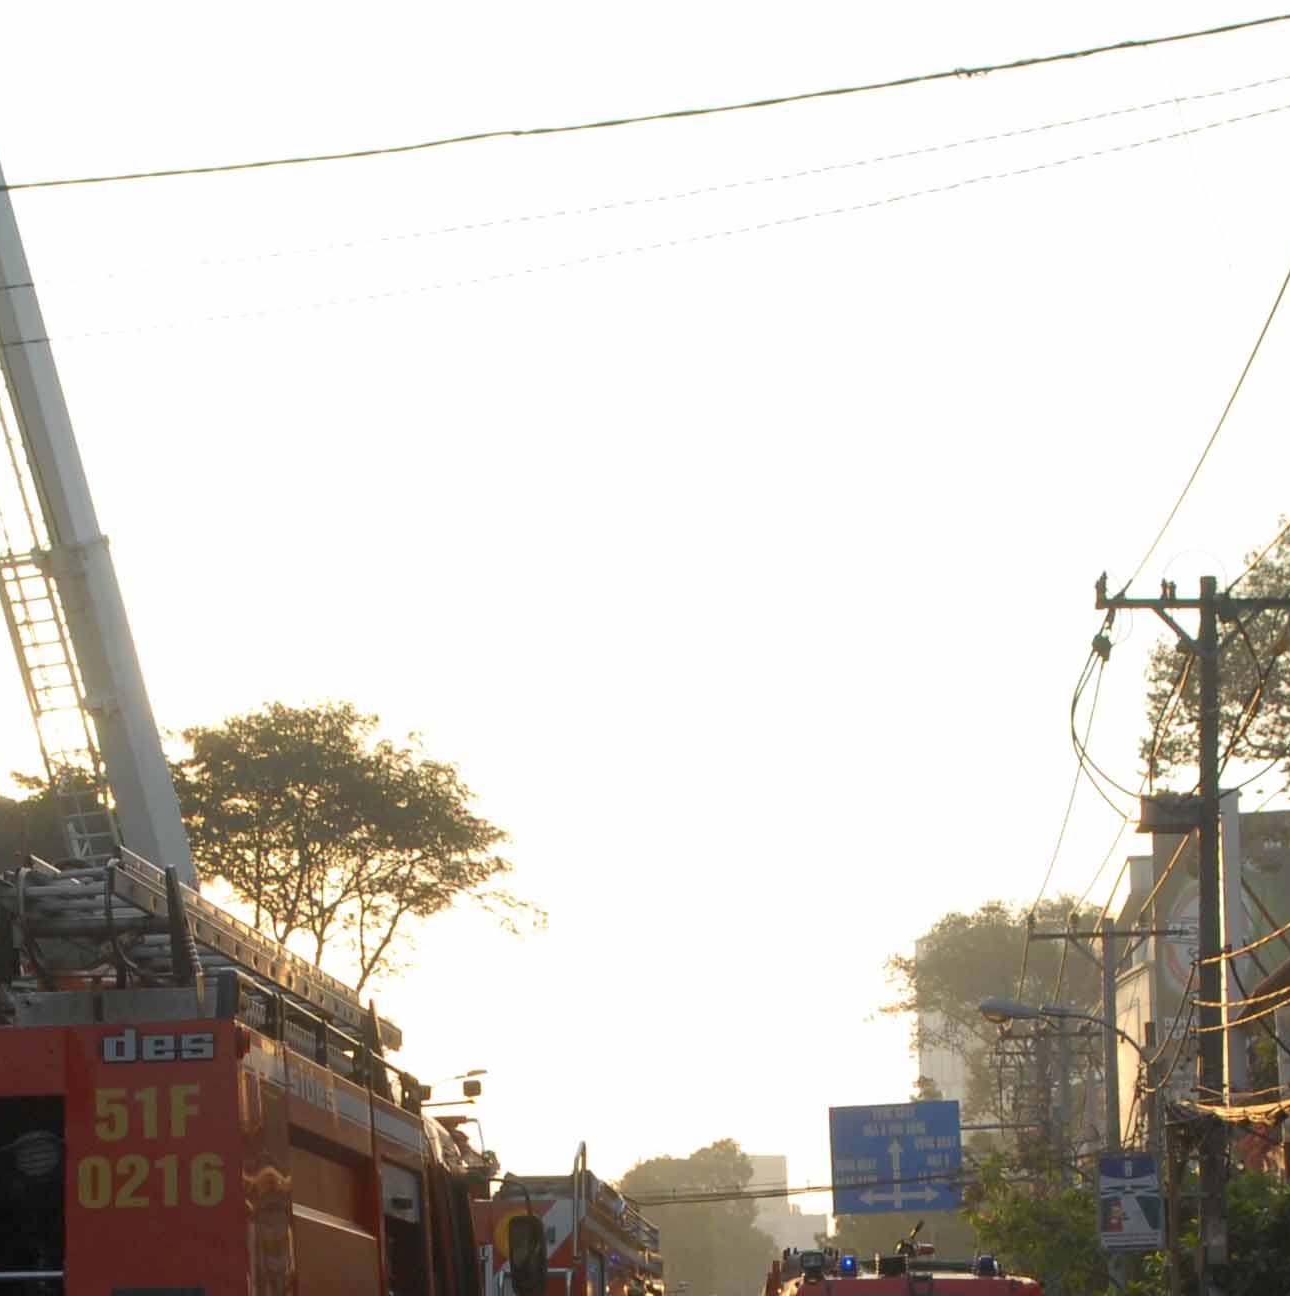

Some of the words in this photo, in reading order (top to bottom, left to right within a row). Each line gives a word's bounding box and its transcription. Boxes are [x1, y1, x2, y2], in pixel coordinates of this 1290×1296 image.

[102, 1028, 214, 1063] des
[94, 1083, 201, 1142] 51F
[76, 1150, 226, 1211] 0216
